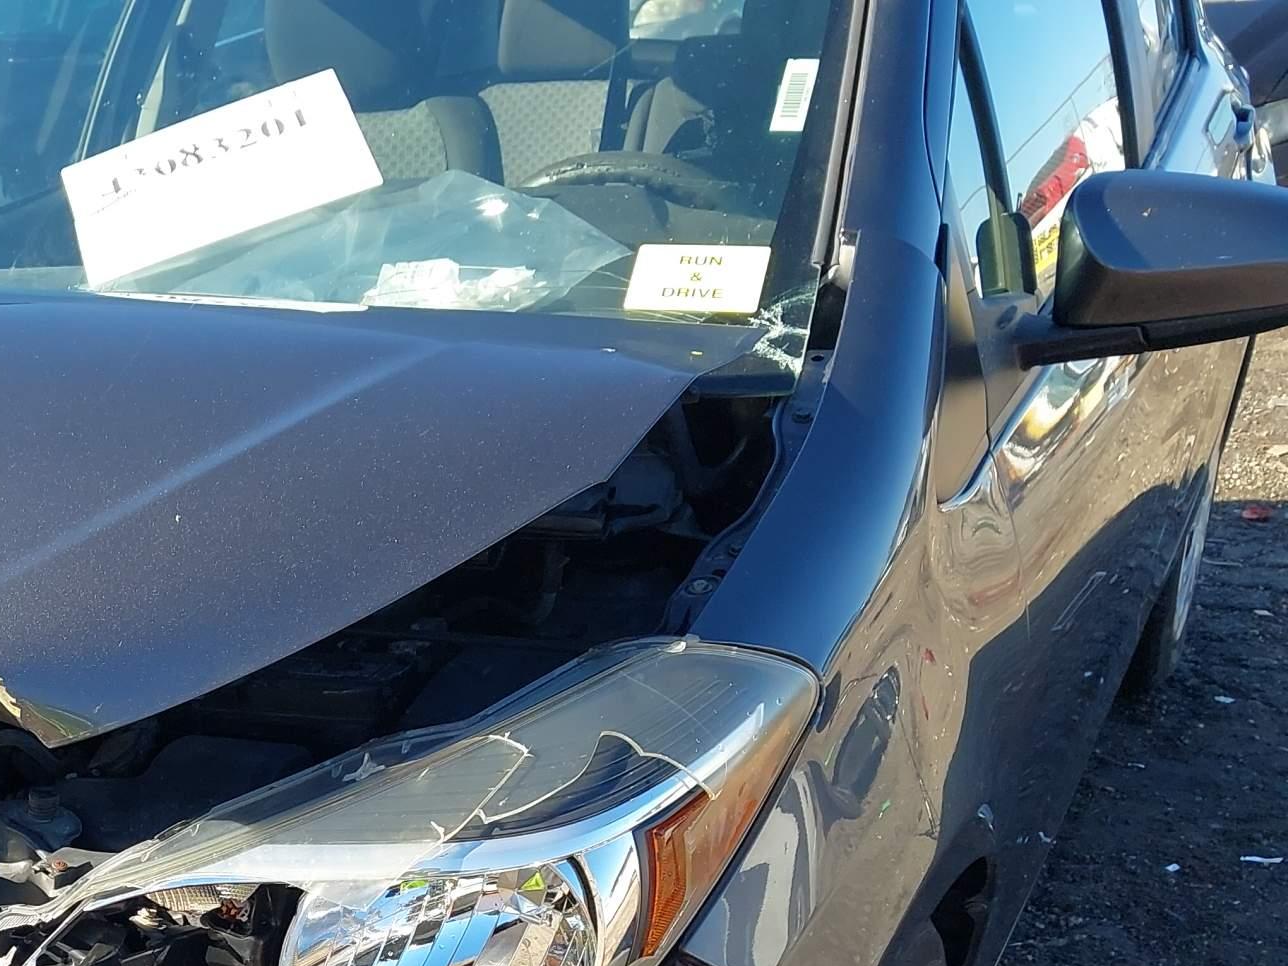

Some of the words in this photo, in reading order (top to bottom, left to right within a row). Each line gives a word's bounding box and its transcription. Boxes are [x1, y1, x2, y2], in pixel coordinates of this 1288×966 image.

[100, 108, 308, 197] 83201
[679, 255, 724, 266] RUN
[690, 272, 702, 282] &
[661, 287, 724, 299] DRIVE
